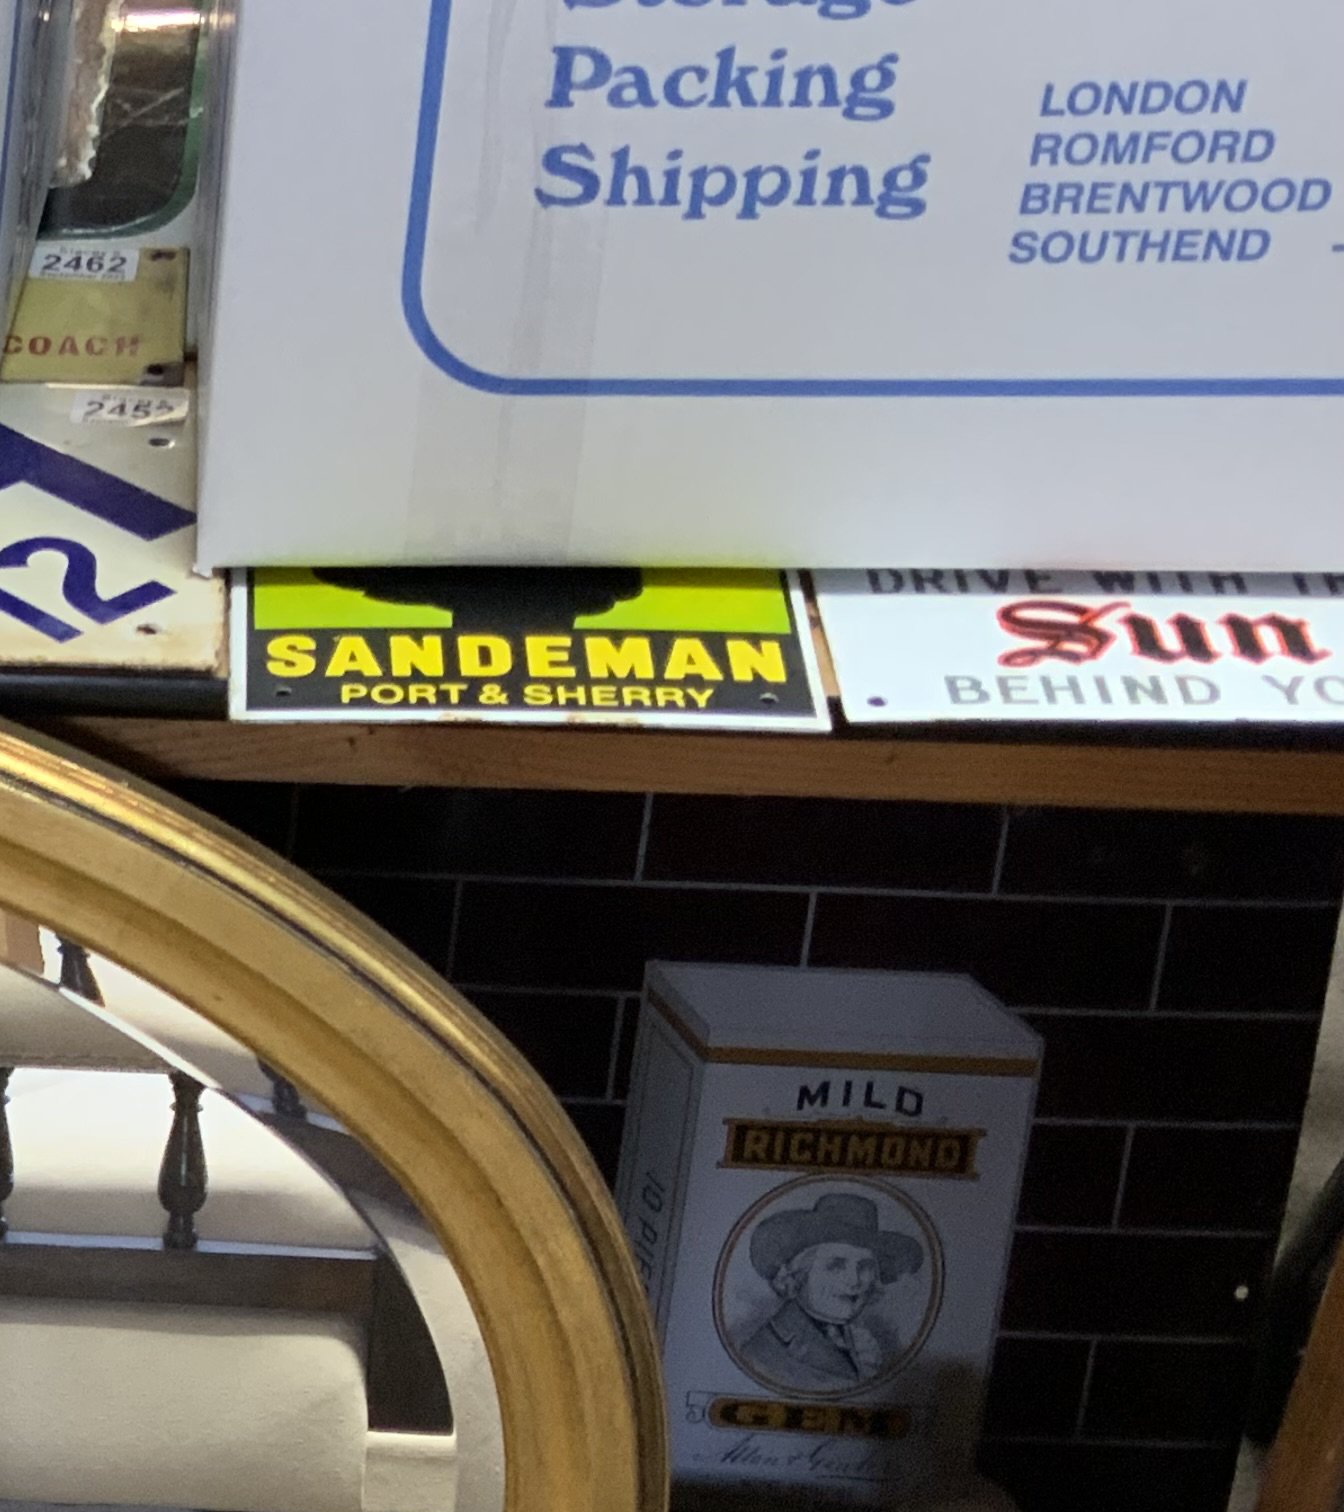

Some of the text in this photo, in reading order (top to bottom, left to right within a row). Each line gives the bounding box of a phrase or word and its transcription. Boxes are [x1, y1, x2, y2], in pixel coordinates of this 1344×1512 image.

[544, 44, 900, 122] Packing
[1039, 79, 1248, 117] LONDON
[1029, 129, 1276, 166] ROMFORD
[534, 142, 931, 220] Shipping
[1019, 178, 1332, 215] BRENTWOOD
[42, 253, 128, 273] 2462
[1009, 229, 1271, 264] SOUTHEND
[4, 335, 141, 356] COACH
[997, 599, 1331, 668] Sun
[266, 634, 787, 683] SANDEMAN
[341, 683, 715, 709] PORT & SHERRY
[944, 674, 1221, 706] BEHIND
[796, 1080, 923, 1117] MILD
[743, 1129, 962, 1168] RICHMOND
[720, 1402, 894, 1437] GEM
